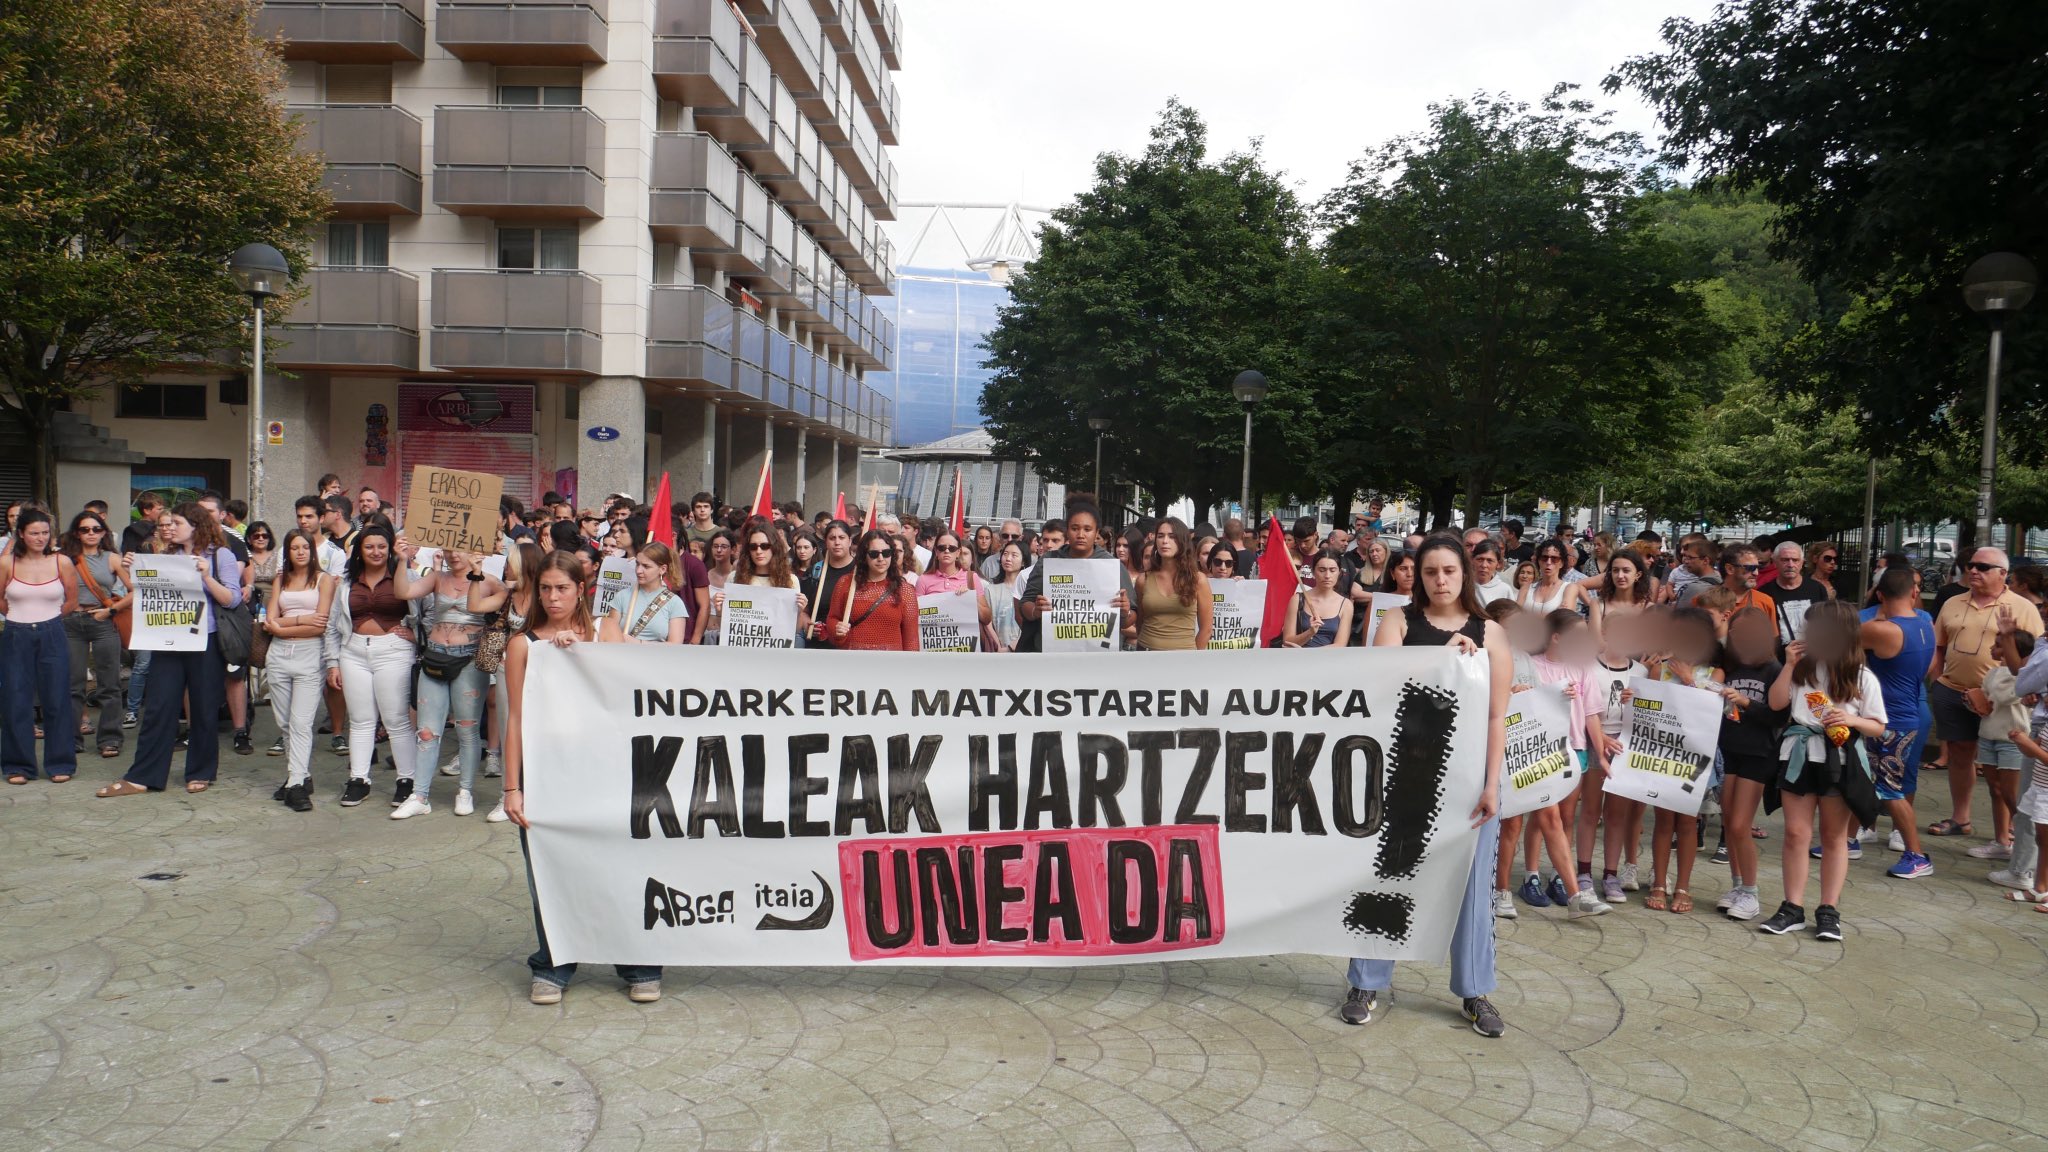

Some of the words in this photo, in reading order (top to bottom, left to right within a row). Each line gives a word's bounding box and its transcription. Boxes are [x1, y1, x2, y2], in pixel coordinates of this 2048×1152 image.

[429, 472, 481, 499] ERASO
[414, 526, 484, 552] JUSTIZIA
[142, 589, 183, 600] KALEAK
[141, 600, 198, 612] HARTZEKO
[1051, 599, 1095, 612] KALEAK
[146, 612, 177, 626] UNEA
[1051, 611, 1109, 624] HARTZEKO
[1212, 616, 1242, 629] ALEAK
[729, 623, 773, 638] KALEAK
[922, 625, 959, 638] KALEAK
[1056, 624, 1088, 639] UNEA
[1210, 627, 1254, 641] ARTZEKO
[923, 636, 971, 649] HARTZEKO
[634, 688, 899, 718] INDARKERIA
[911, 689, 1207, 718] MATXISTAREN
[1222, 689, 1371, 718] AURKA
[1633, 698, 1650, 709] ASKI
[1633, 707, 1677, 720] INDARKERIA
[1633, 713, 1682, 728] MATXISTAREN
[1506, 719, 1538, 733] DARKERIA
[1632, 718, 1656, 728] AURKA
[1631, 723, 1685, 748] KALEAK
[1505, 731, 1547, 760] KALEAK
[1629, 736, 1701, 765] HARTZEKO
[1506, 738, 1560, 775] HARTZEKO
[1630, 754, 1669, 774] UNEA
[1514, 757, 1548, 789] UNEA
[631, 733, 943, 838] KALEAK
[967, 727, 1386, 838] HARTZEKO
[755, 882, 814, 908] itaia
[862, 840, 1081, 949] UNEA
[1106, 839, 1212, 945] DA
